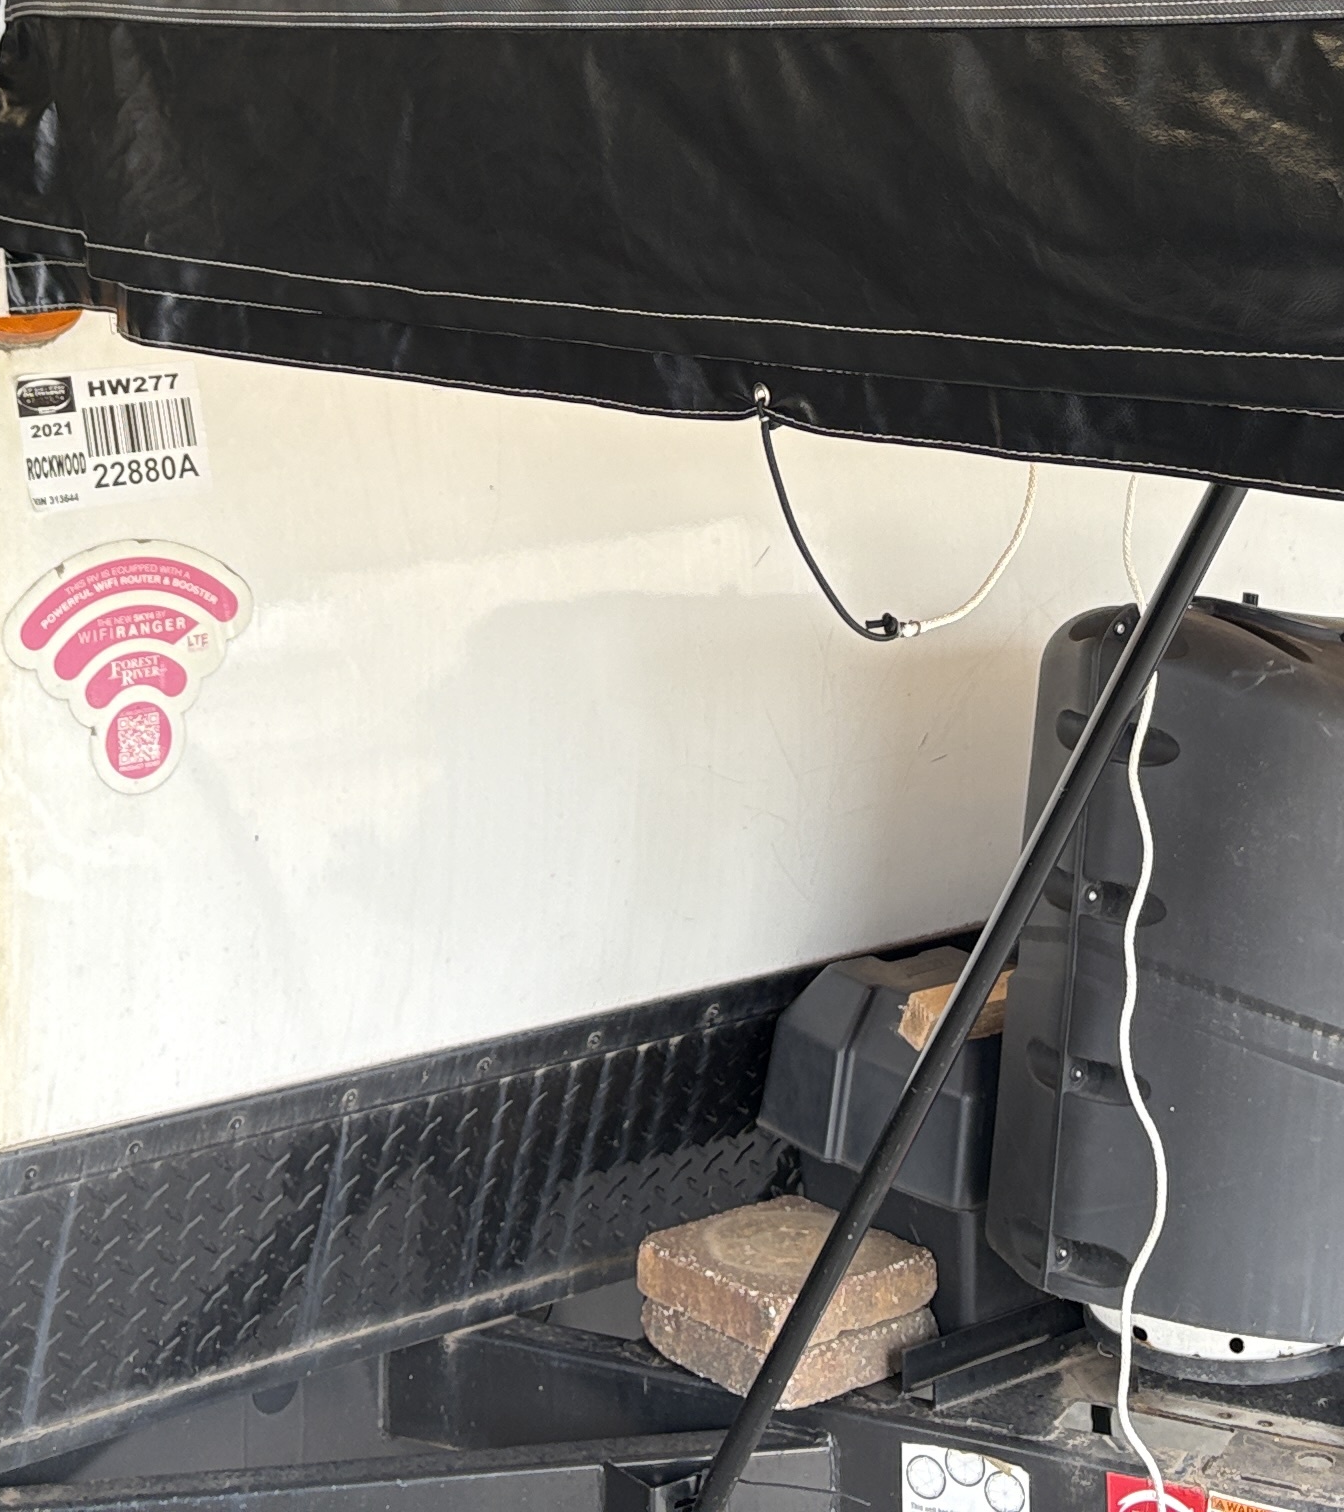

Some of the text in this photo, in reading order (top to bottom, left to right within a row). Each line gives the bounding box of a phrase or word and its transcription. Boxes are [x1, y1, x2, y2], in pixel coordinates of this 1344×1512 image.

[87, 372, 179, 397] HW277
[30, 420, 73, 439] 2021
[25, 452, 87, 481] ROCKWOOD
[92, 453, 200, 489] 22880A
[63, 563, 191, 595] THIS RV IS EQUIPPED WITH A
[40, 588, 95, 630] POWERFUL
[119, 574, 162, 586] ROUTER
[162, 575, 171, 586] &
[171, 577, 219, 605] BOOSTER
[77, 616, 187, 645] WIFIRANGER
[107, 654, 161, 681] FOREST
[120, 665, 163, 688] RIVER
